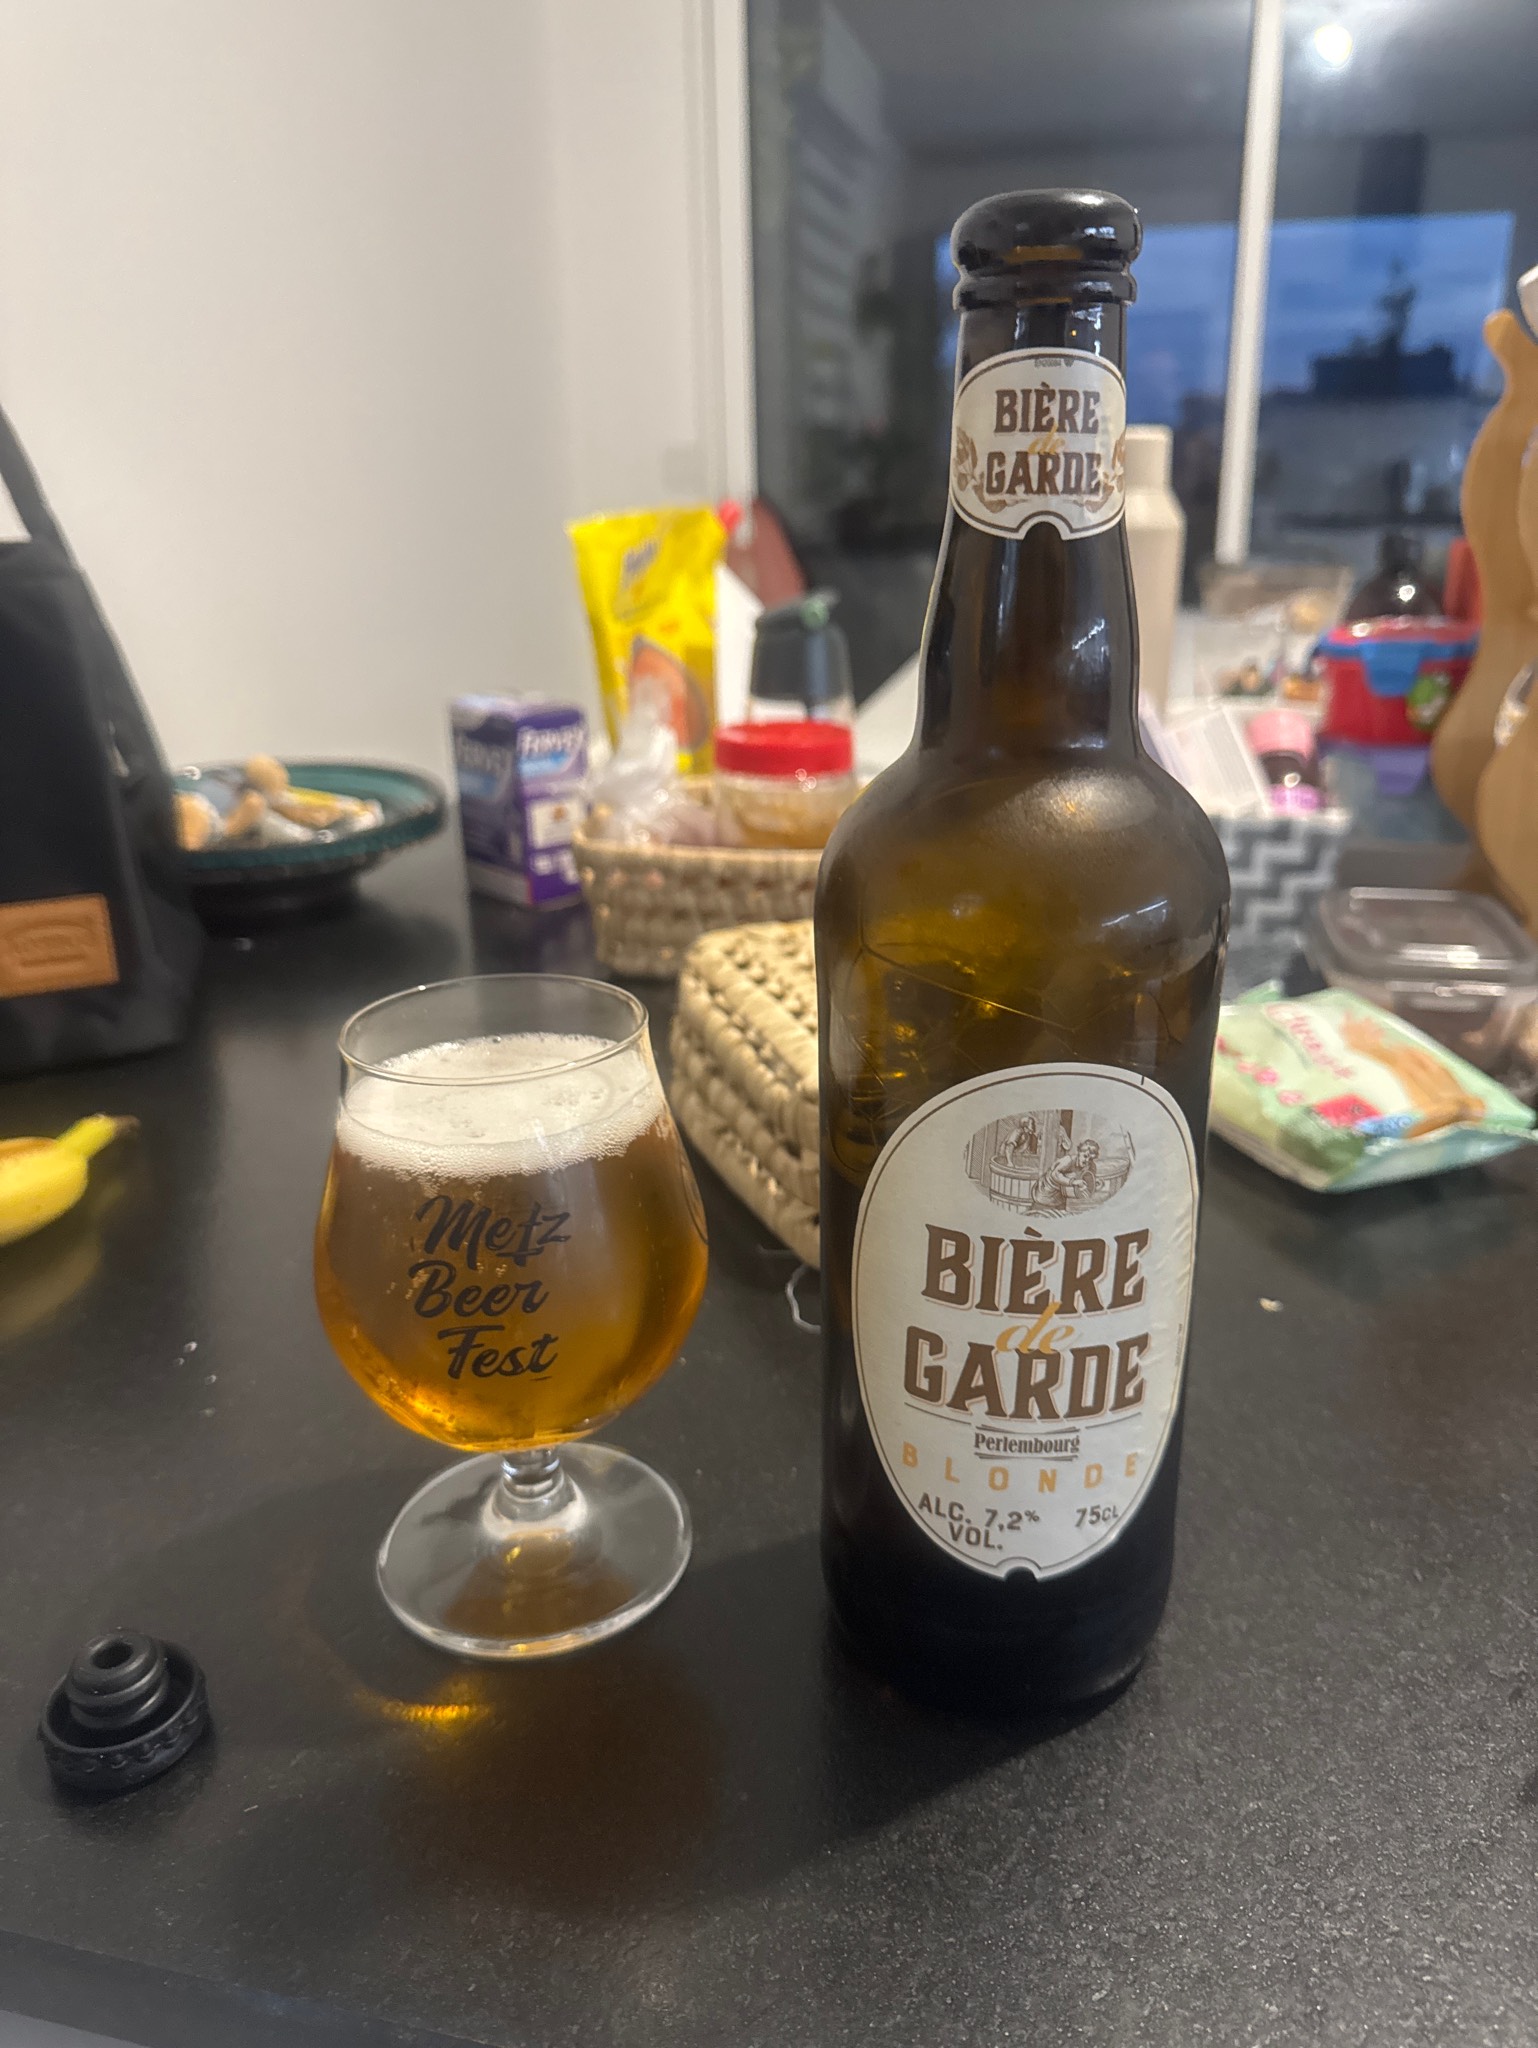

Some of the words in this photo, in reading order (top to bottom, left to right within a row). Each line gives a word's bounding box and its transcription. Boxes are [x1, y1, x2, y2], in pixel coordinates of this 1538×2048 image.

[994, 381, 1101, 434] BIÈRE
[1027, 424, 1066, 456] de
[985, 451, 1102, 495] GARDE
[415, 1195, 571, 1270] Metz
[408, 1260, 549, 1318] Beer
[921, 1223, 1152, 1317] BIÈRE
[438, 1325, 559, 1380] Fest
[996, 1300, 1076, 1354] de
[903, 1325, 1151, 1422] GARDE
[974, 1432, 1081, 1454] Perlembourg
[918, 1492, 972, 1525] ALC.
[948, 1521, 1004, 1550] VOL.
